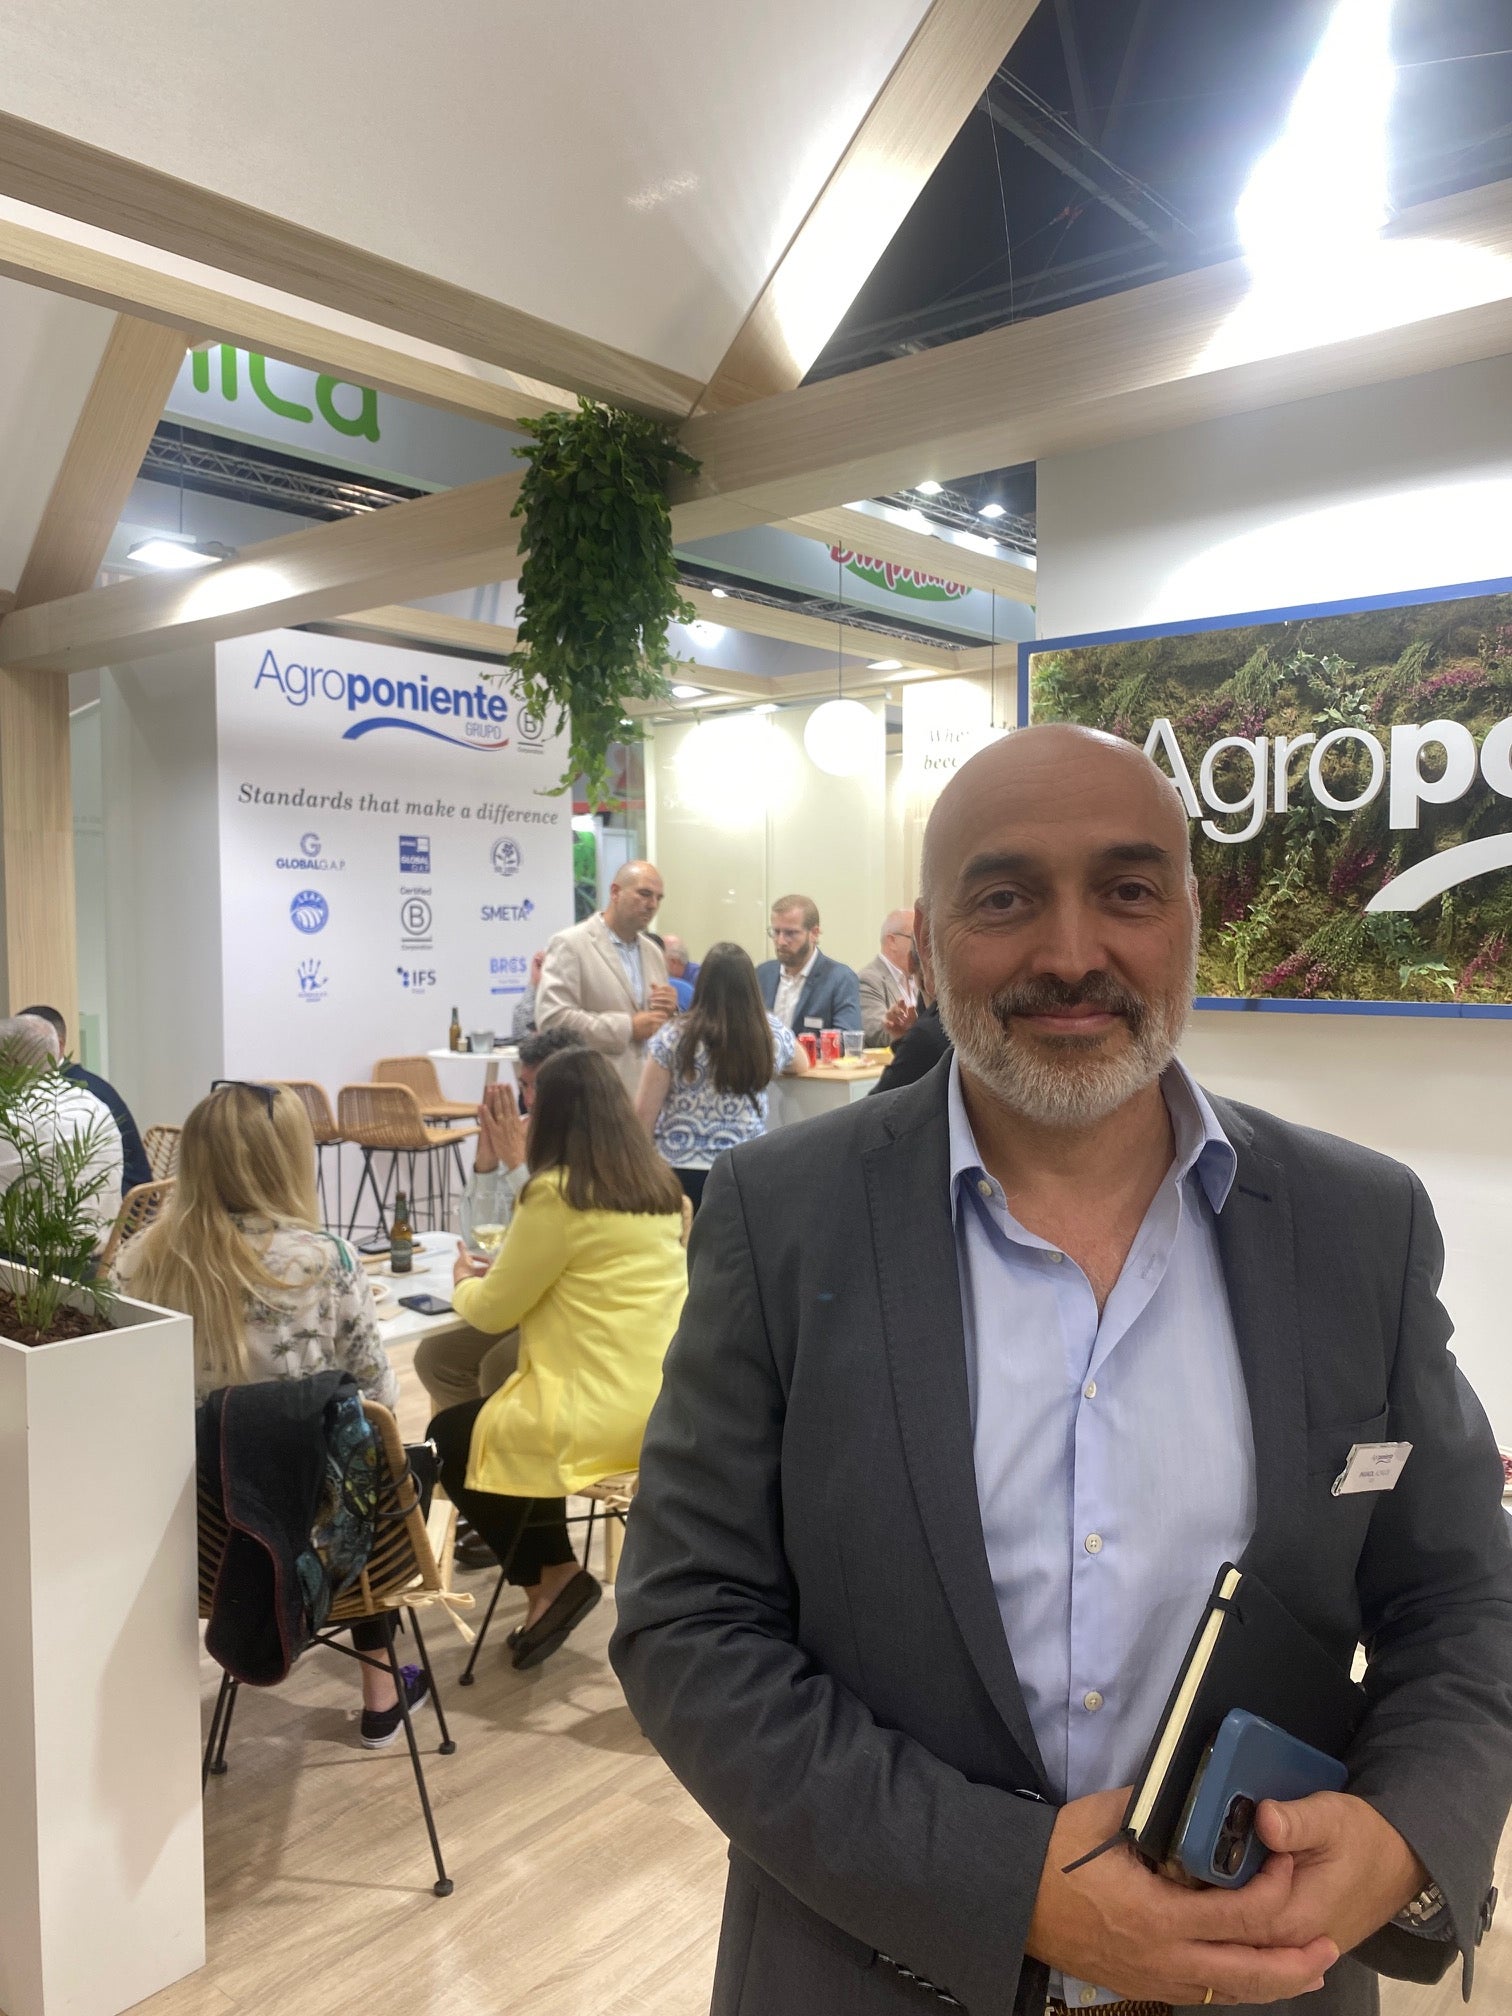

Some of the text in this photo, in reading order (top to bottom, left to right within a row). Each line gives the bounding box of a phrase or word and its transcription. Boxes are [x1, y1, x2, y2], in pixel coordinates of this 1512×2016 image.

[254, 649, 509, 723] Agroponiente
[465, 721, 502, 740] GRUPO
[238, 782, 559, 826] Standards that make a difference
[409, 905, 425, 928] B
[481, 905, 528, 921] SMETA
[412, 969, 437, 986] IFS
